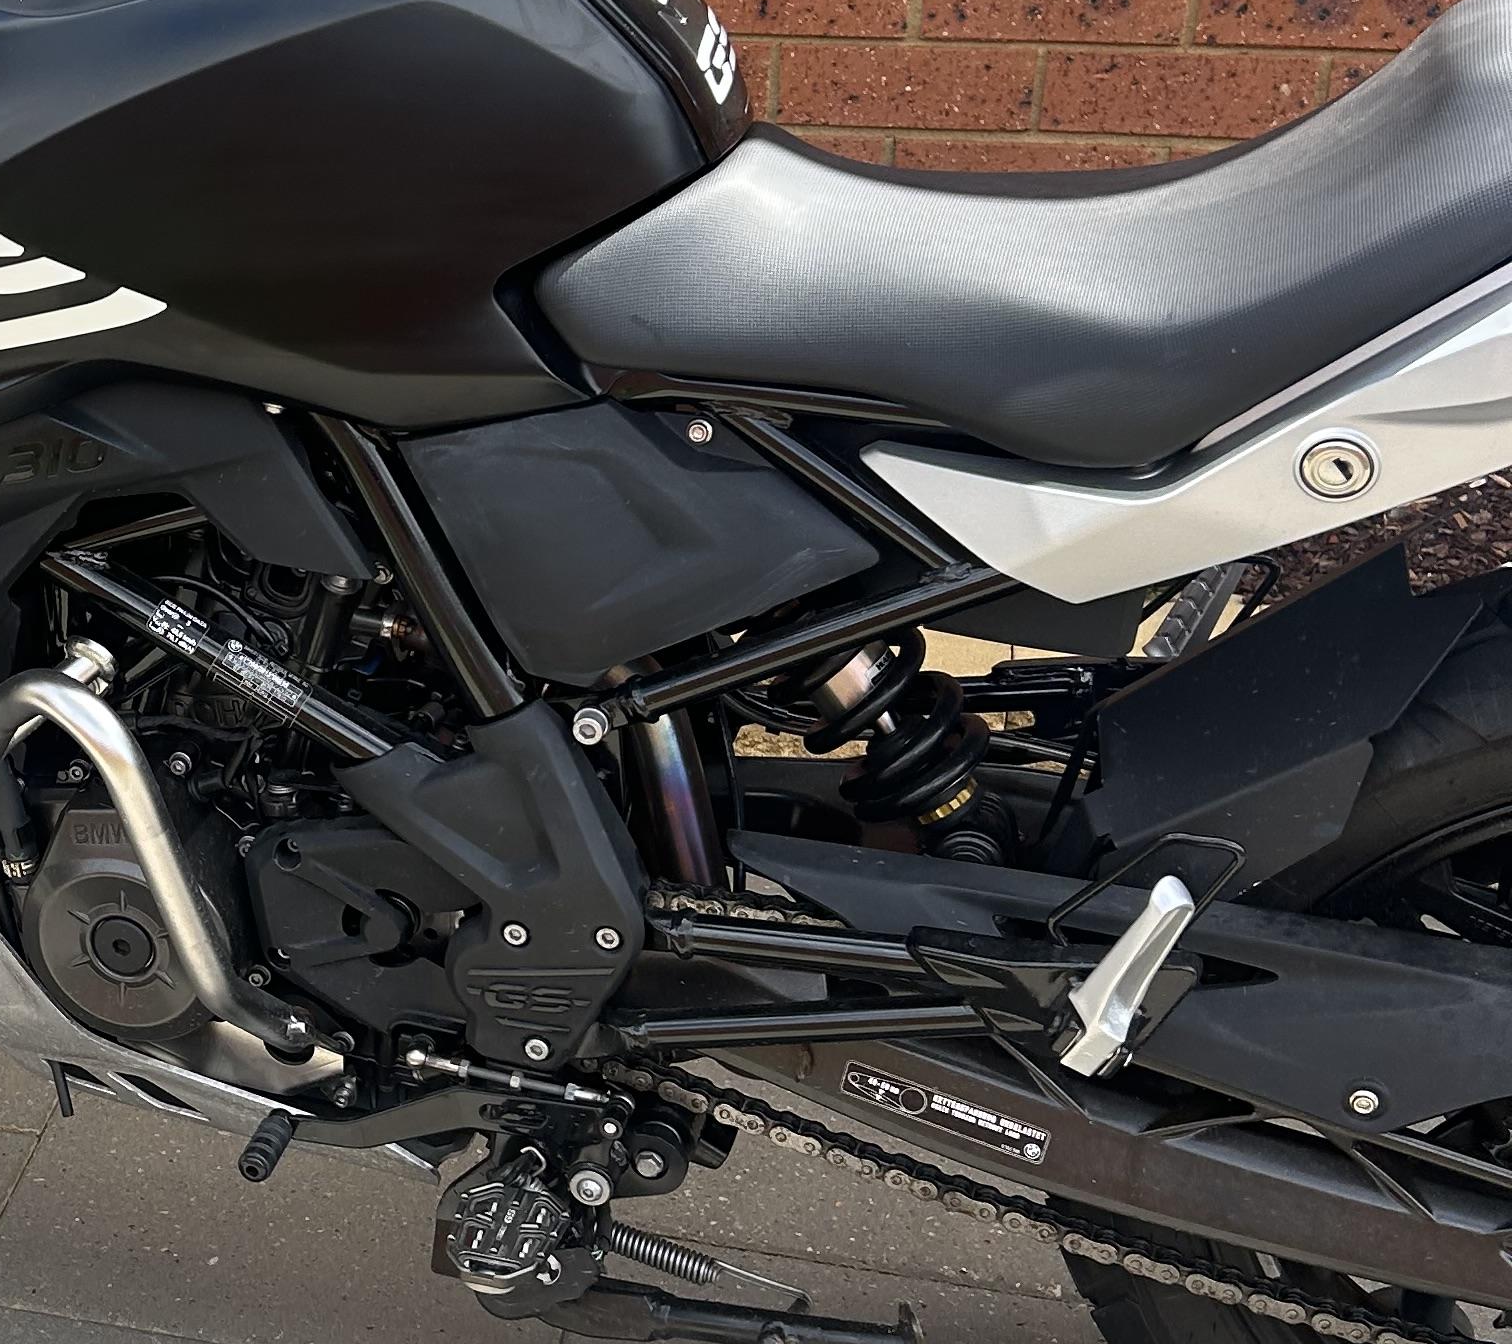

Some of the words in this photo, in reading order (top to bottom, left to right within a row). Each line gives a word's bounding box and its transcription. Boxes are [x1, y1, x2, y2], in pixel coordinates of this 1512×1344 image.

[1, 438, 108, 487] 310
[73, 822, 129, 846] BMW
[485, 983, 572, 1013] GS
